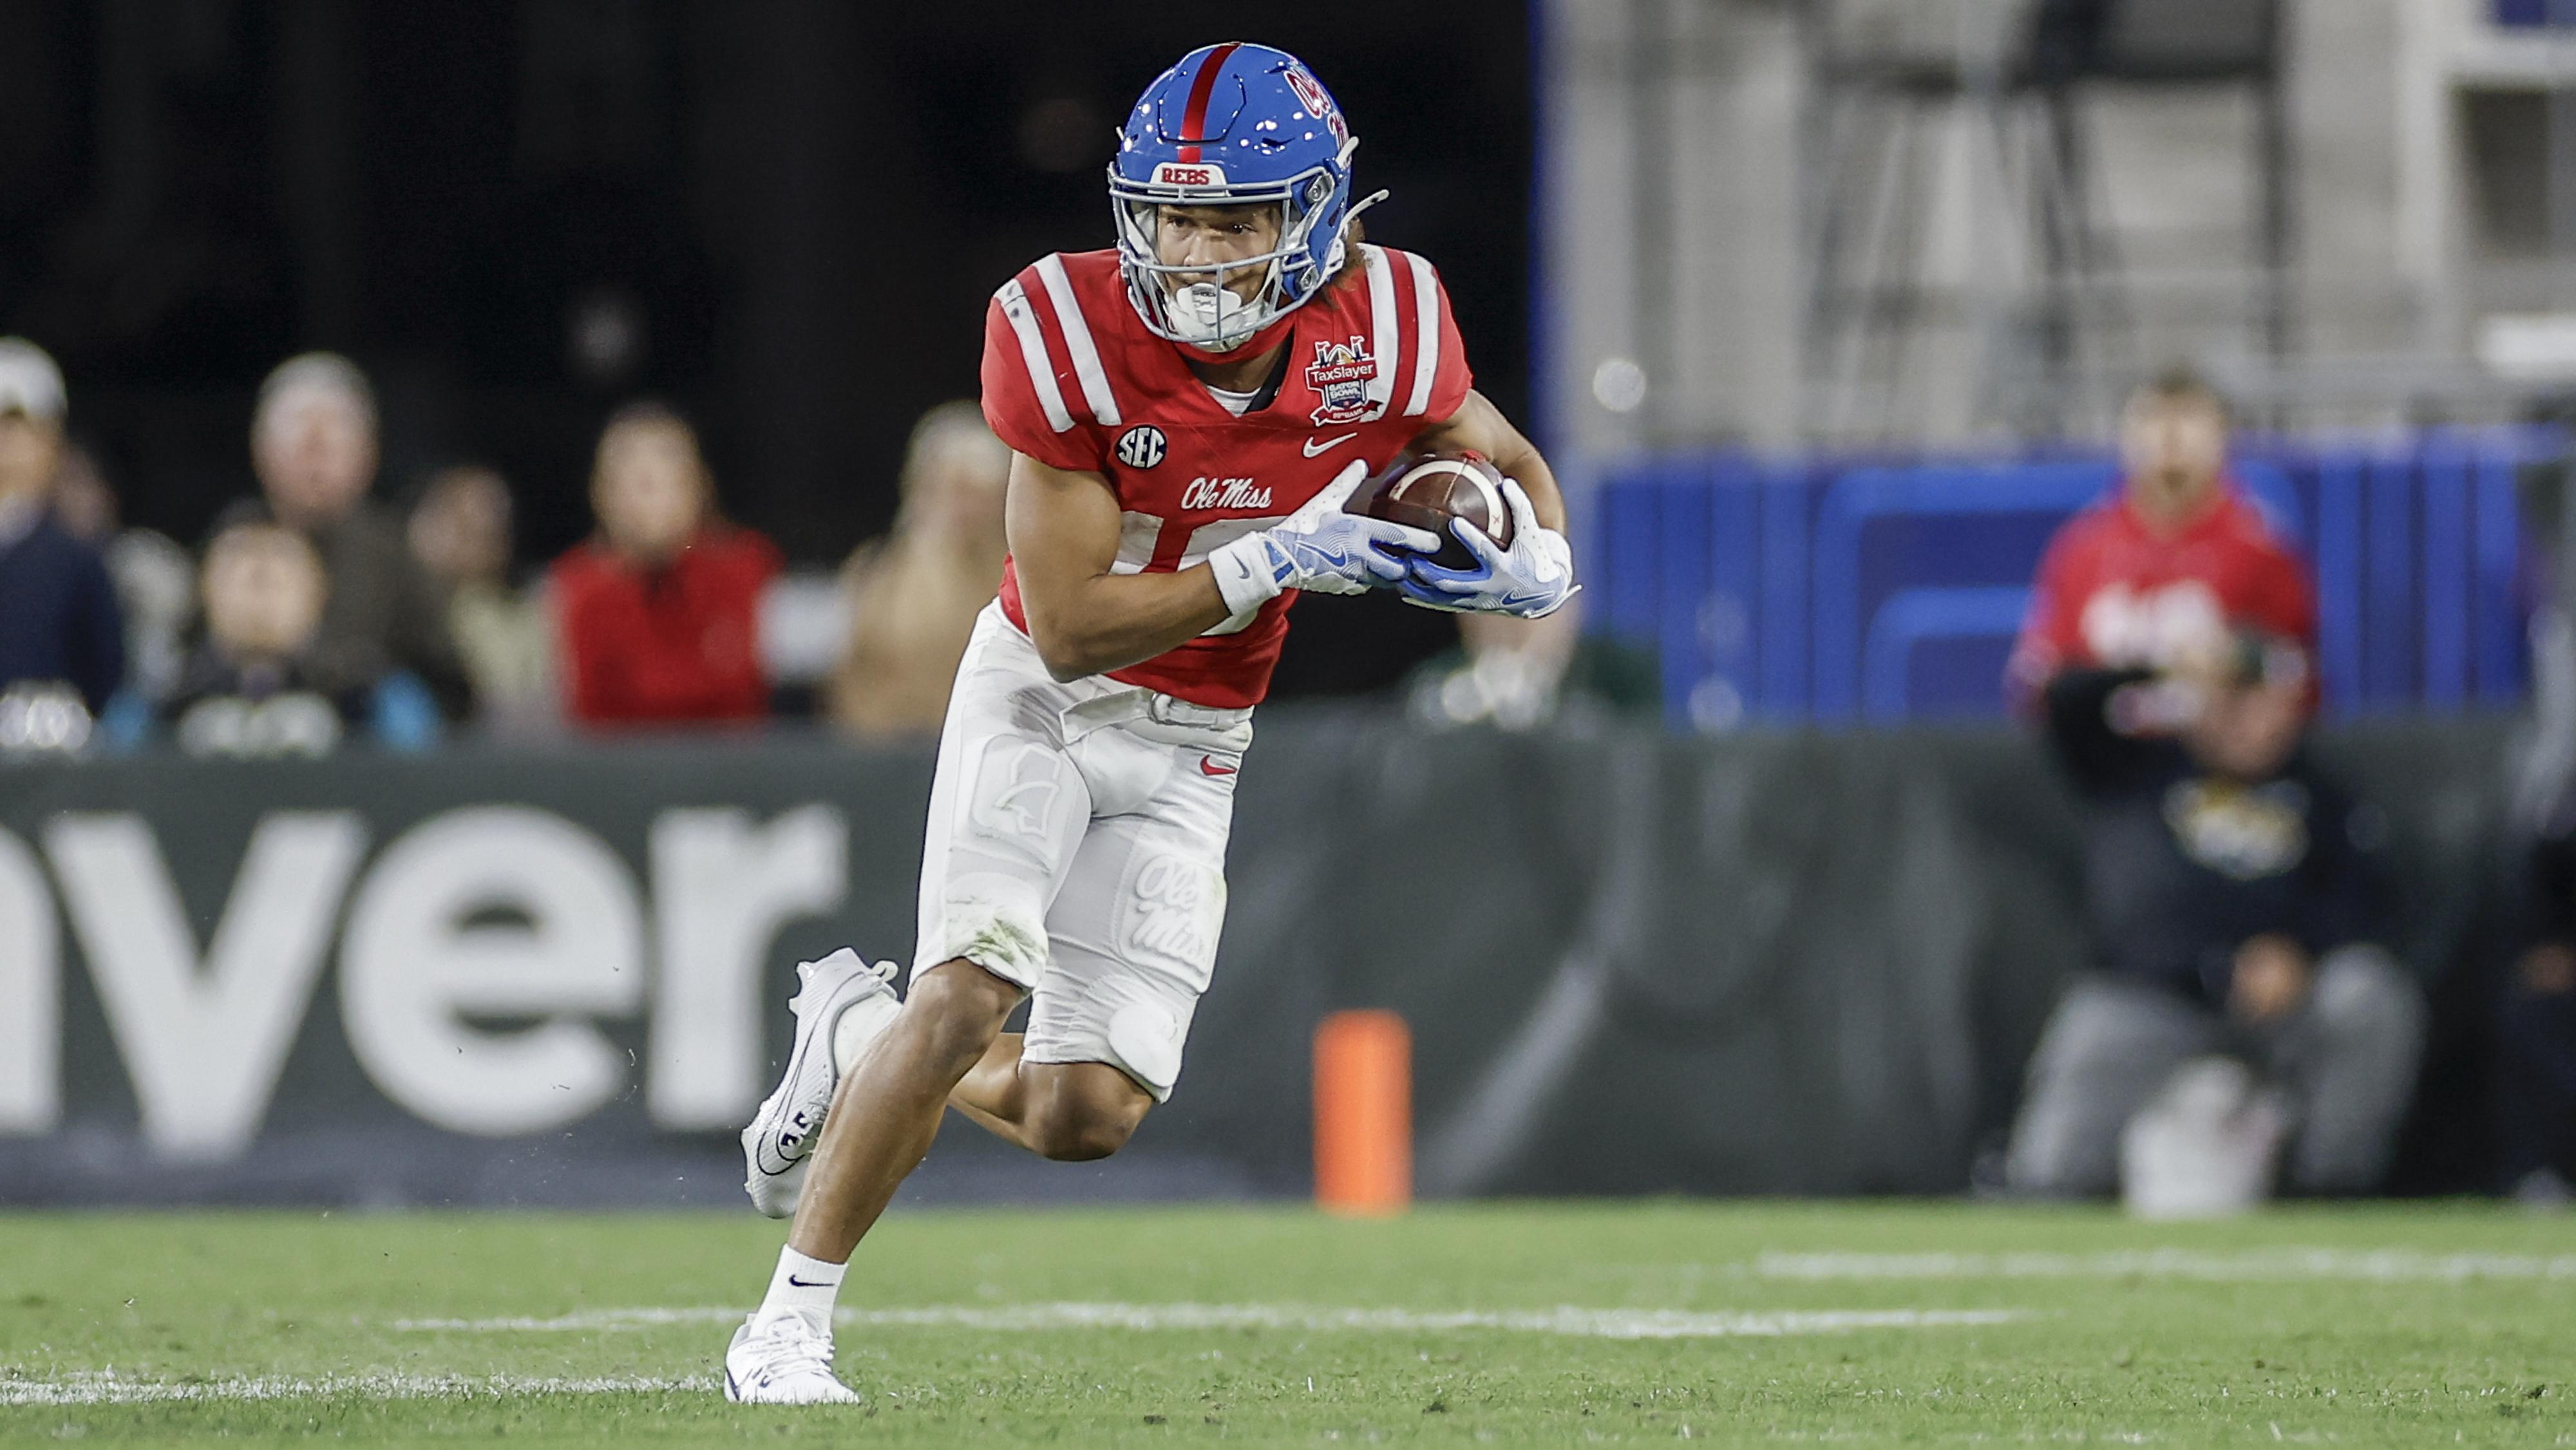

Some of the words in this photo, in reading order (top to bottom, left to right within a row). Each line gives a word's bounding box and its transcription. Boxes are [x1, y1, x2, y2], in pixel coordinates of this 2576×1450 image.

[1161, 167, 1210, 185] REBS
[1310, 364, 1374, 382] TaxSlayer
[1330, 388, 1361, 399] BOWL
[1118, 427, 1165, 468] SEC
[1181, 476, 1219, 509] Ole
[1217, 477, 1273, 509] Miss
[0, 803, 849, 1156] ver
